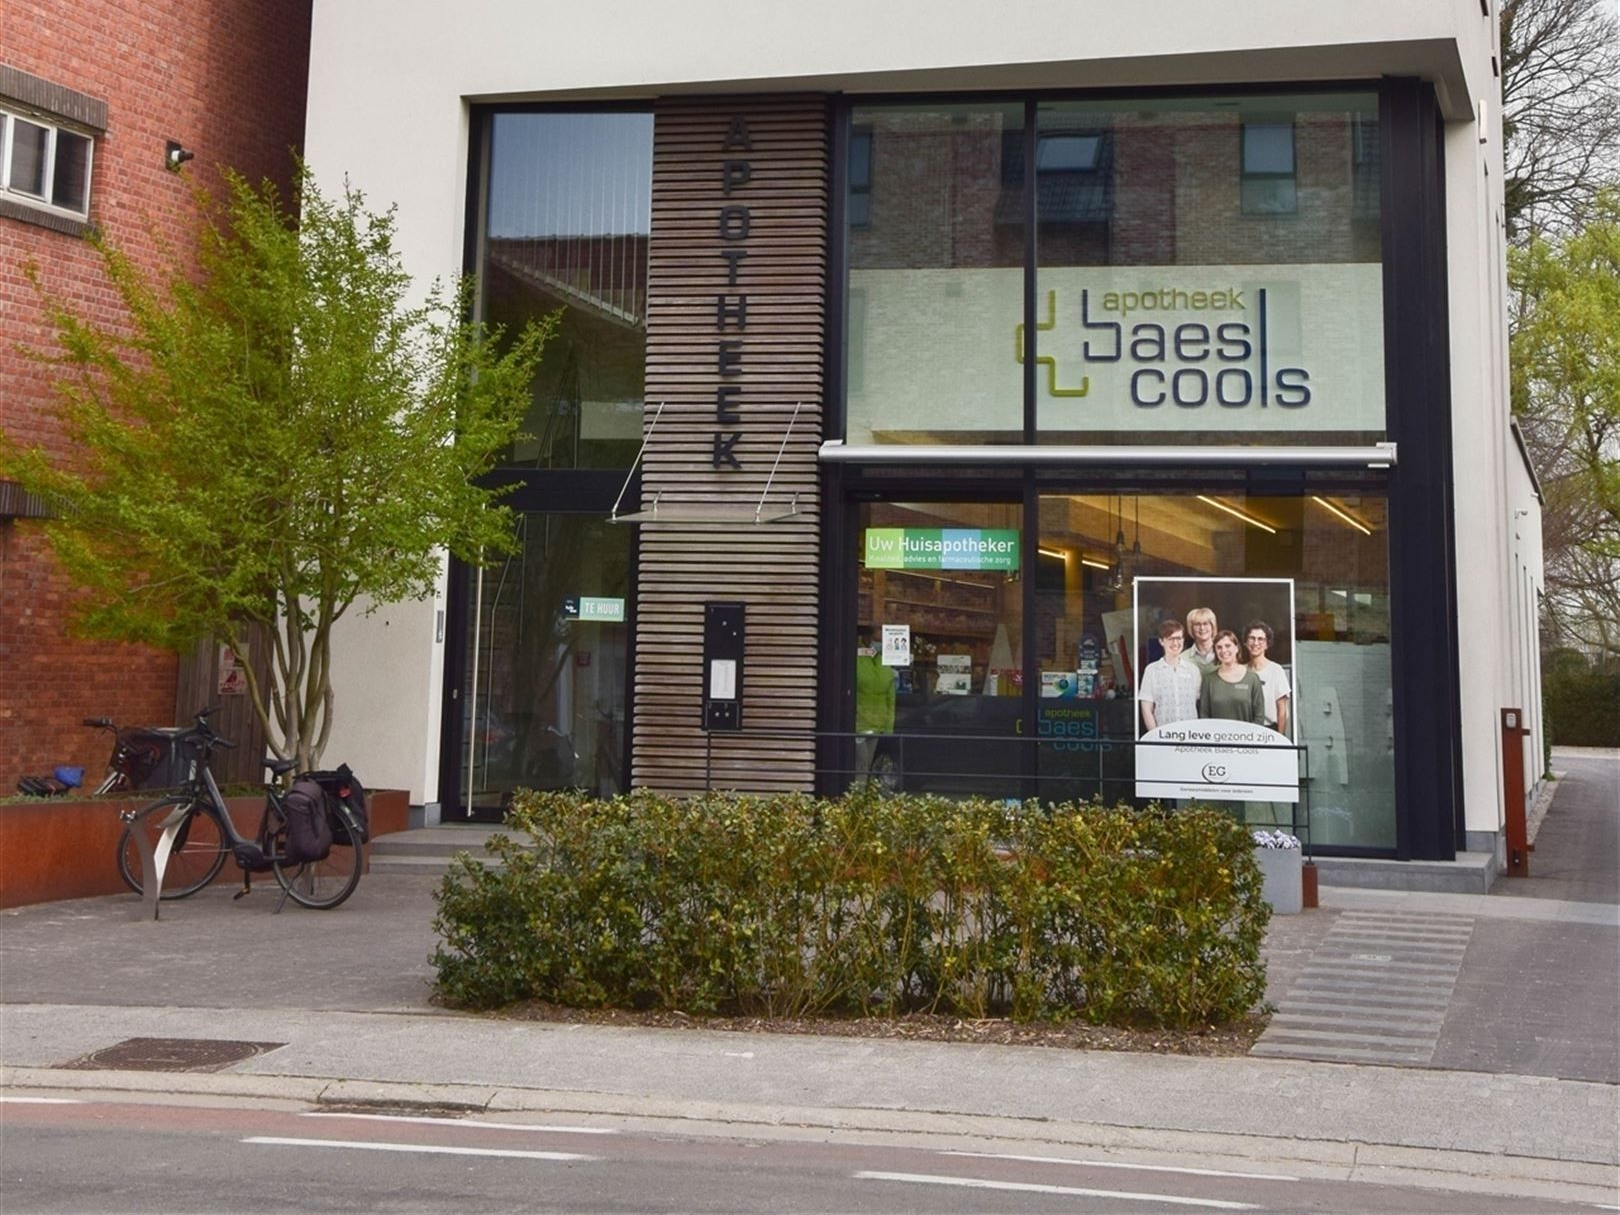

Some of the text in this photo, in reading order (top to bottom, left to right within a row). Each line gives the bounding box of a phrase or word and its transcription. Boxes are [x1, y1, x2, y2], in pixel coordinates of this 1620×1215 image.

[713, 113, 752, 470] APOTHEEK
[1103, 287, 1246, 316] apotheek
[1082, 289, 1252, 363] baes
[1131, 288, 1311, 408] cools
[869, 536, 1014, 554] Uw Huisapotheker
[904, 555, 926, 563] advies
[995, 557, 1011, 565] zorg
[585, 602, 595, 614] TE
[597, 602, 620, 615] HUUR
[1158, 730, 1275, 744] Lang leve gezond zijn
[1208, 765, 1226, 777] EG
